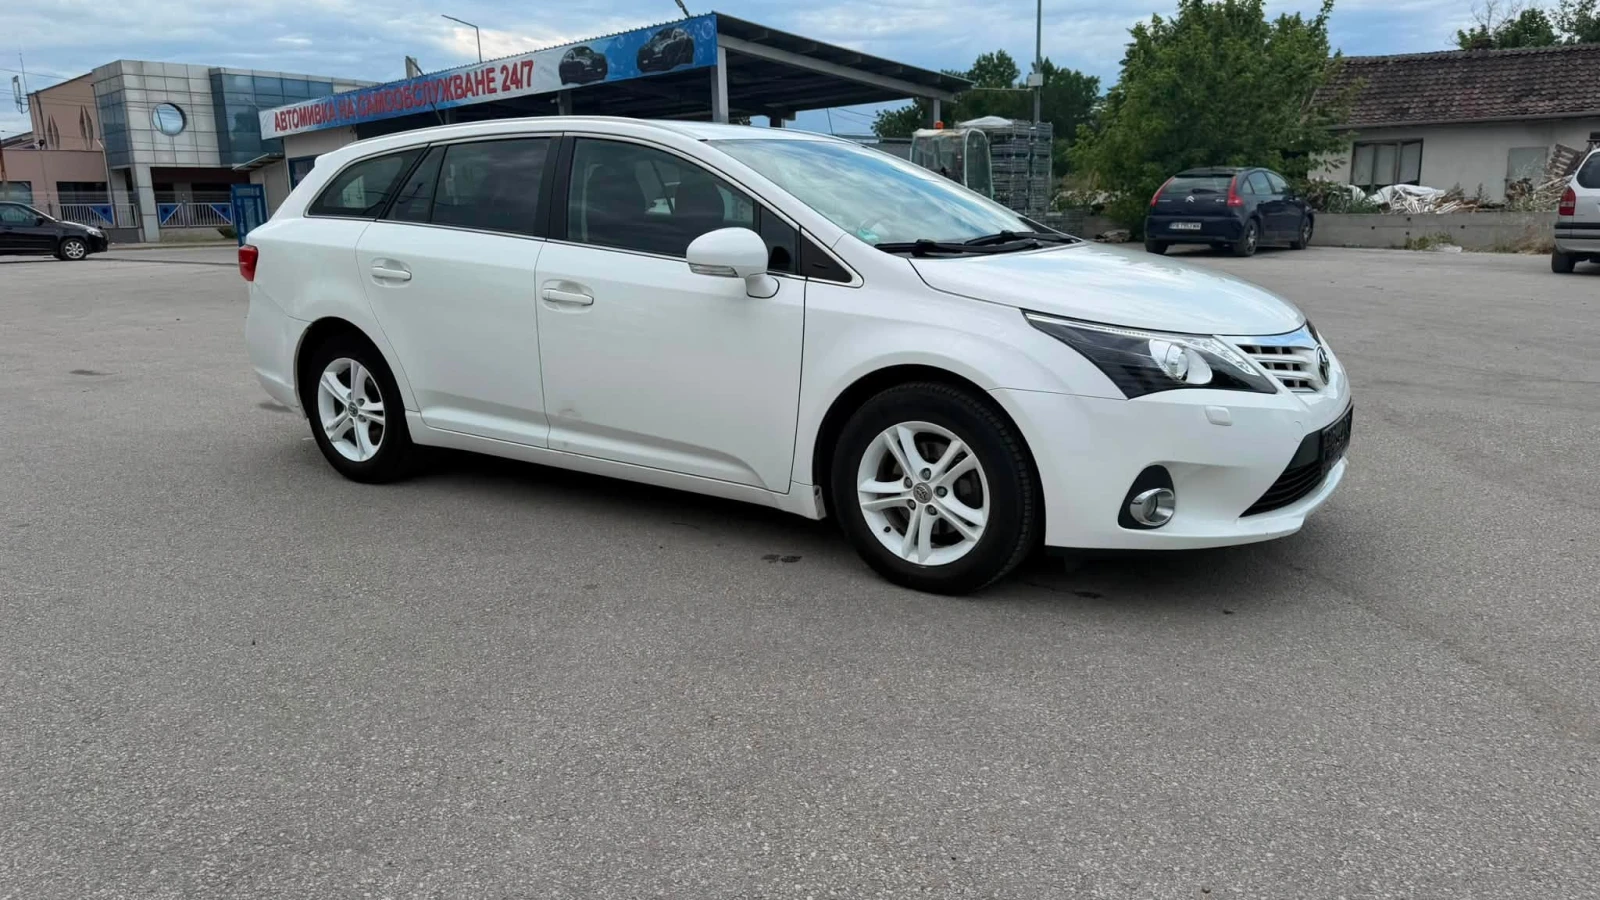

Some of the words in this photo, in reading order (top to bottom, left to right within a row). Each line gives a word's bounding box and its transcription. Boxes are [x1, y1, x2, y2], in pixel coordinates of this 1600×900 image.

[274, 101, 336, 132] АВТОМИВКА
[340, 98, 356, 119] НА
[357, 67, 497, 117] САМООБСЛУЖВАНЕ
[500, 60, 533, 92] 24/7
